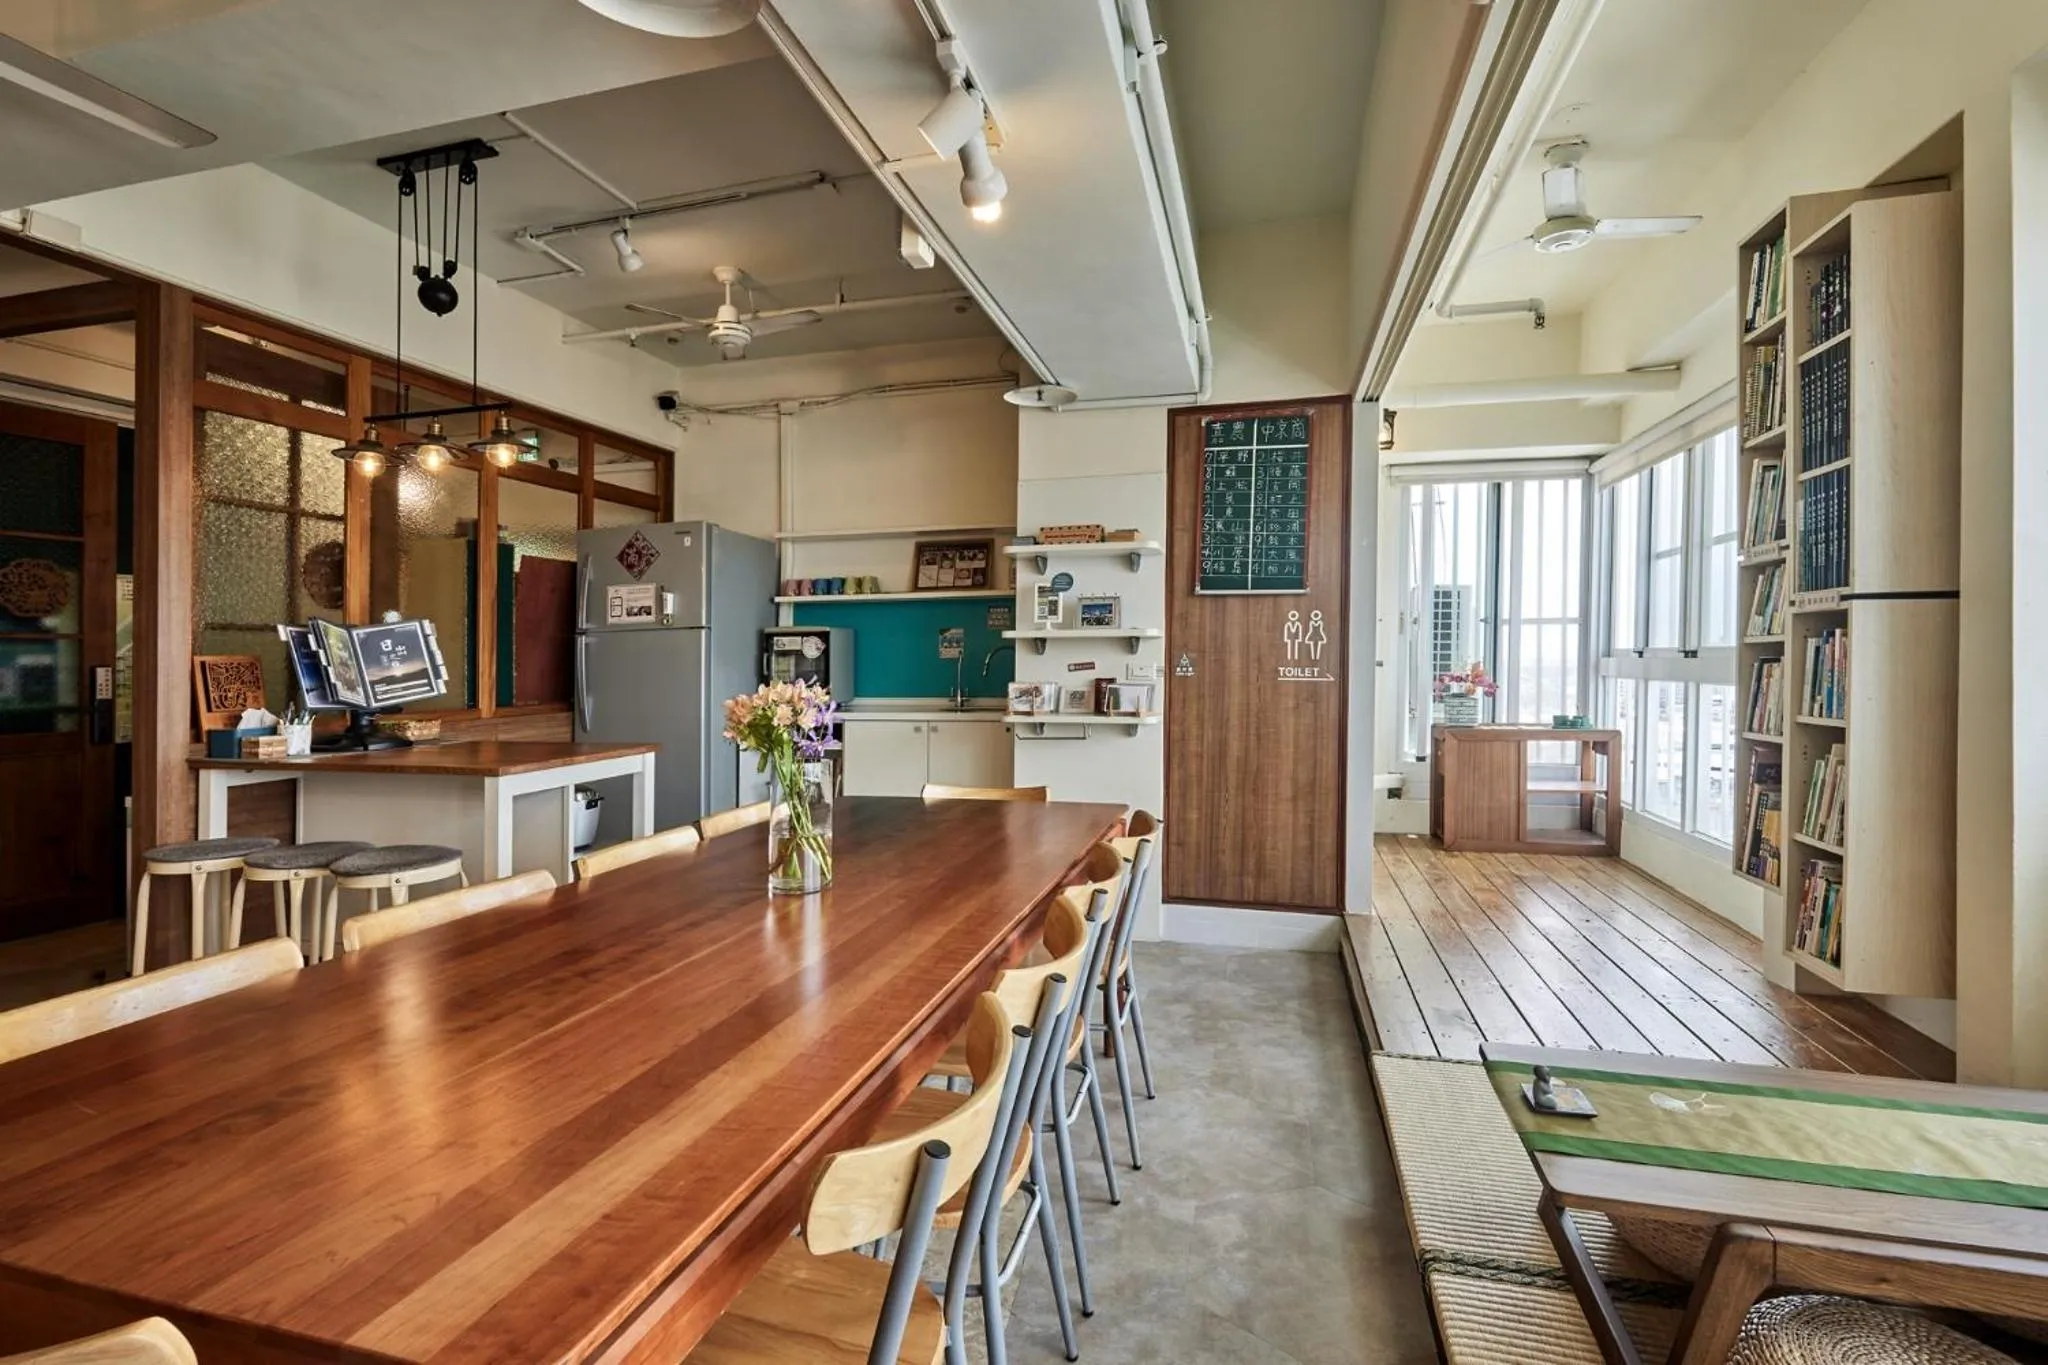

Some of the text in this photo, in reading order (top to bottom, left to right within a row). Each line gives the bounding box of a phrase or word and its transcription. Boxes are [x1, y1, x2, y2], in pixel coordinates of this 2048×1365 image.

[1261, 418, 1305, 442] 中京商
[1278, 667, 1320, 677] TOILET
